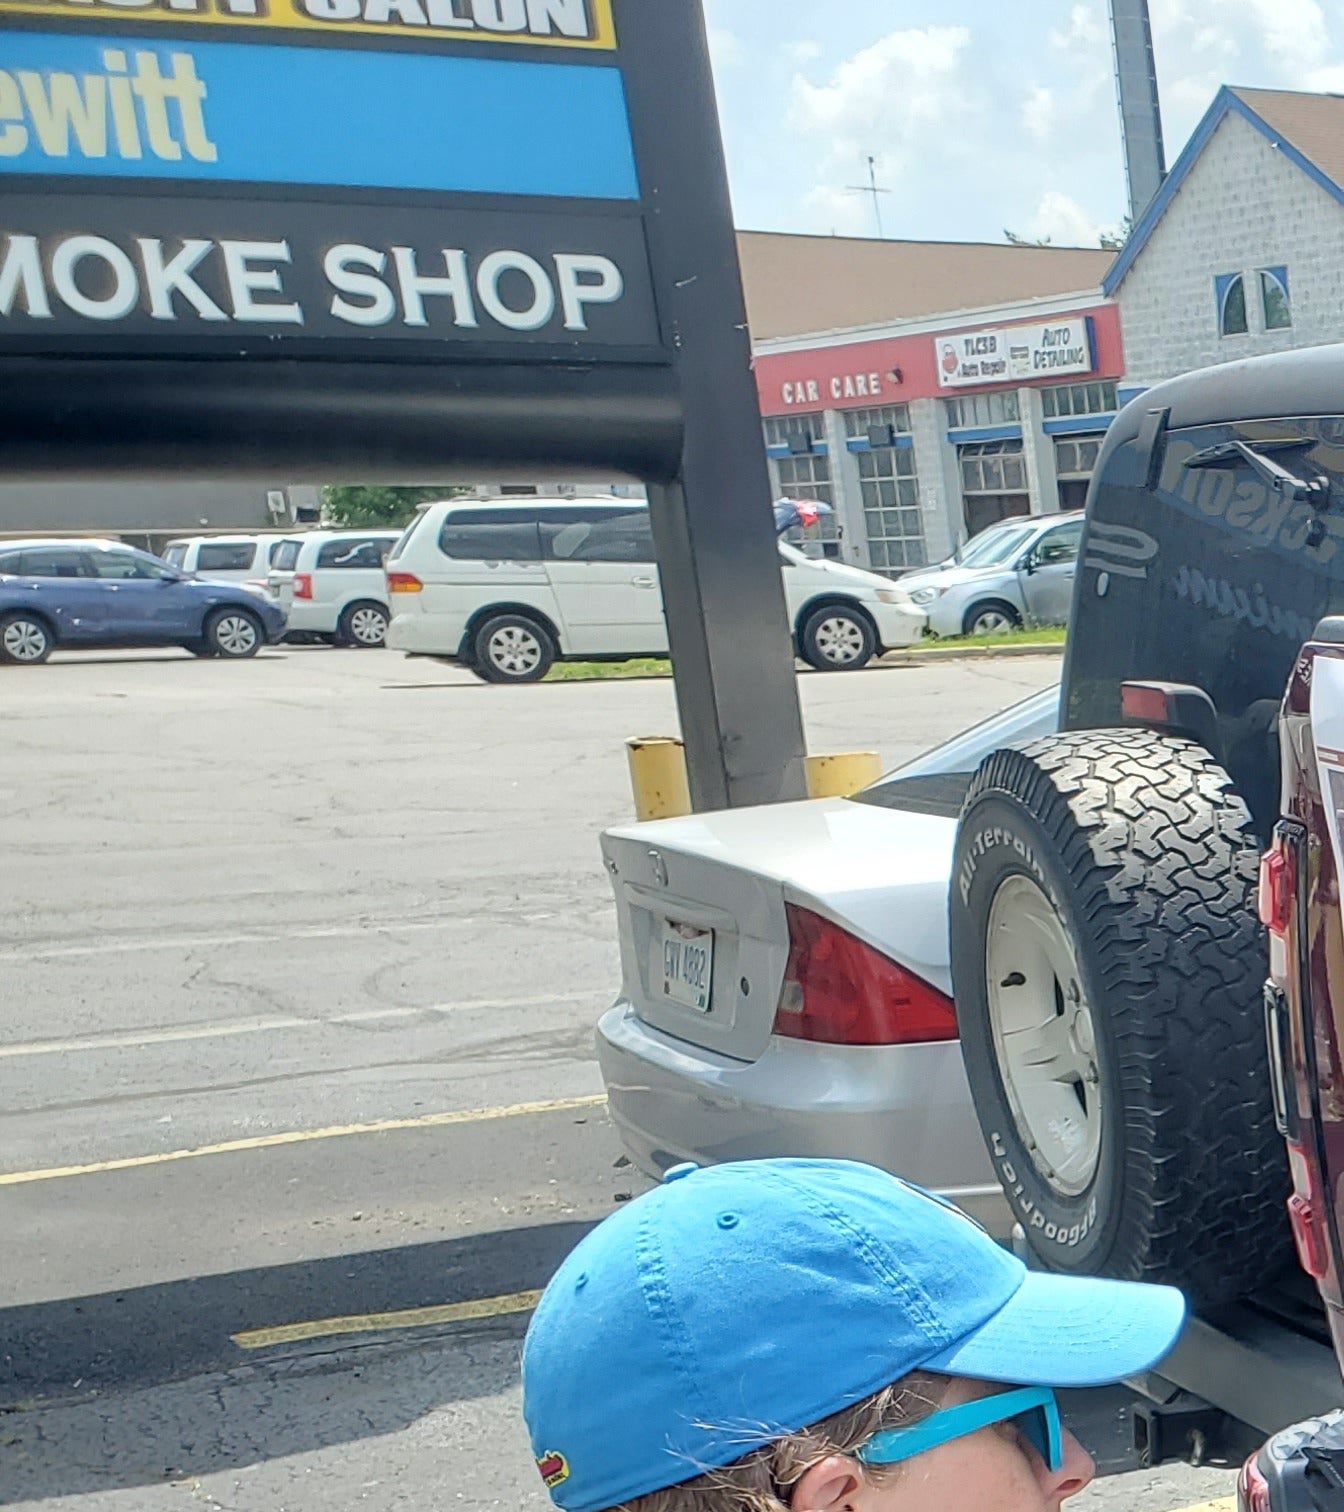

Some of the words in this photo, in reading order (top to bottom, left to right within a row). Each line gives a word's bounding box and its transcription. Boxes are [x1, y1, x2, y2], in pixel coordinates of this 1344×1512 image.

[323, 243, 625, 331] SHOP
[1042, 327, 1071, 348] AUTO
[1033, 347, 1084, 370] DETAILING
[782, 379, 819, 404] CAR
[830, 372, 881, 399] CARE
